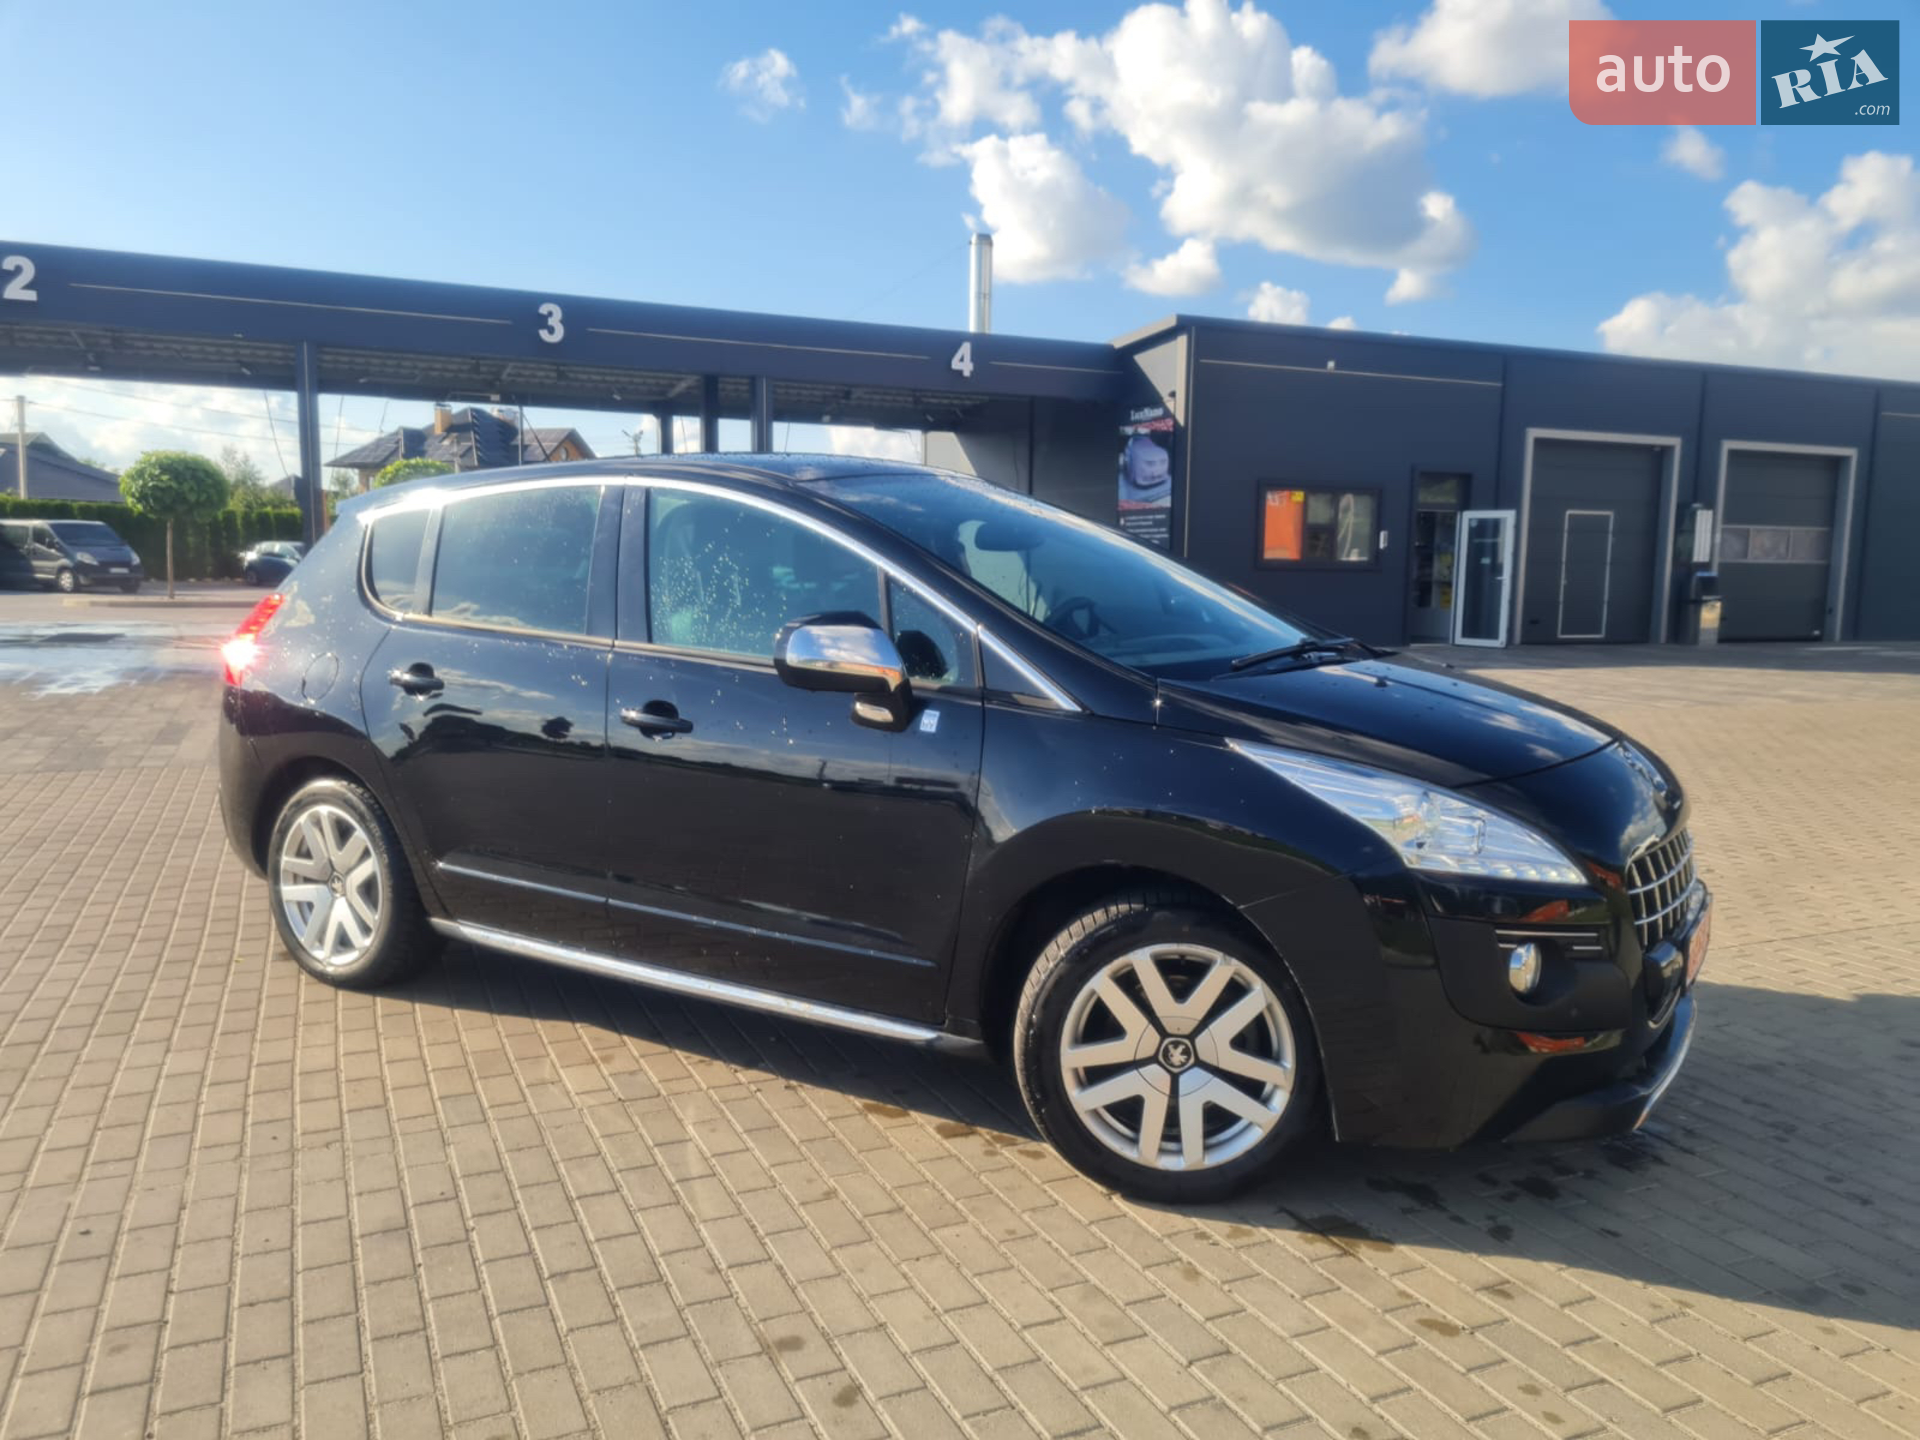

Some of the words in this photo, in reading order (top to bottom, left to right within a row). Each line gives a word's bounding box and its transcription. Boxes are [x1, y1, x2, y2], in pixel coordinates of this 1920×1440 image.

[1, 255, 38, 301] 2
[538, 302, 565, 343] 3
[951, 341, 974, 377] 4
